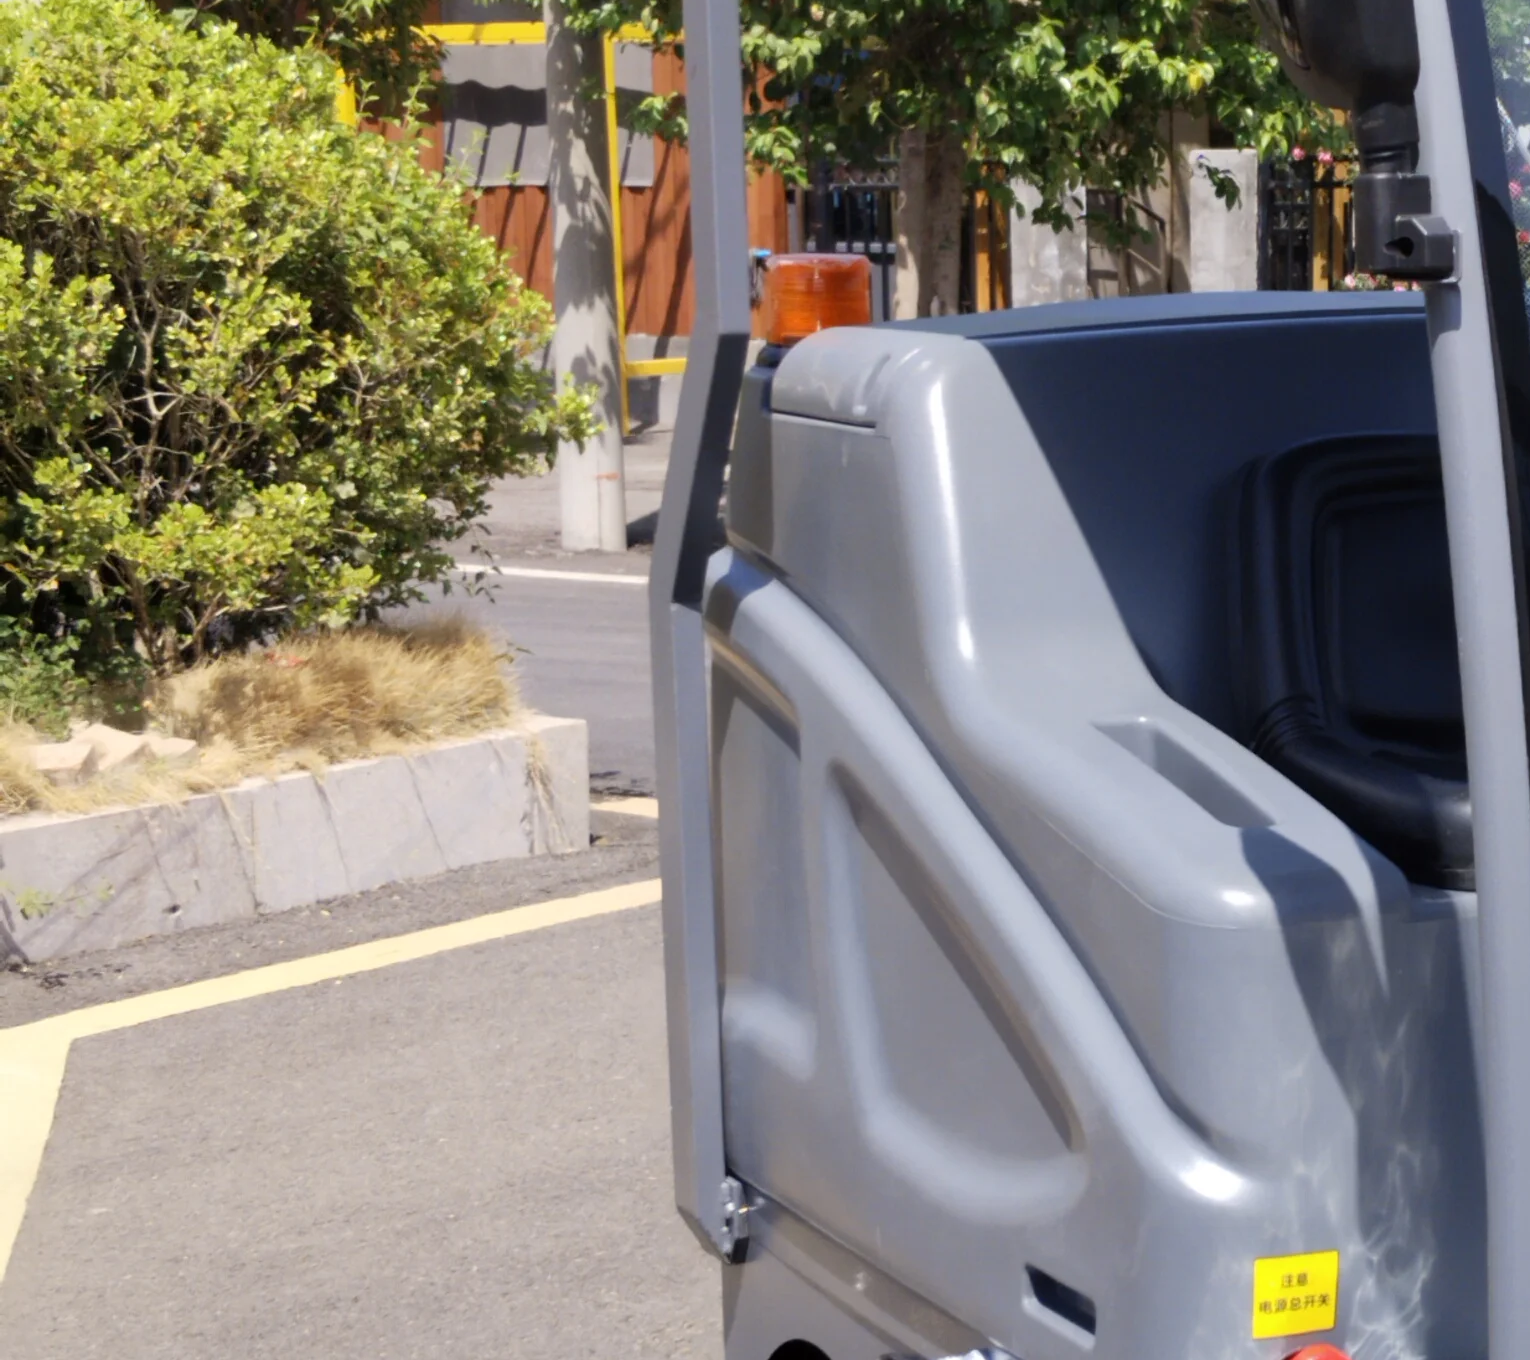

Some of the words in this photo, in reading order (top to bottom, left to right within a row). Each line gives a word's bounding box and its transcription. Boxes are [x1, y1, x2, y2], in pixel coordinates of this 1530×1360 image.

[1258, 1293, 1330, 1314] 电源总开关
